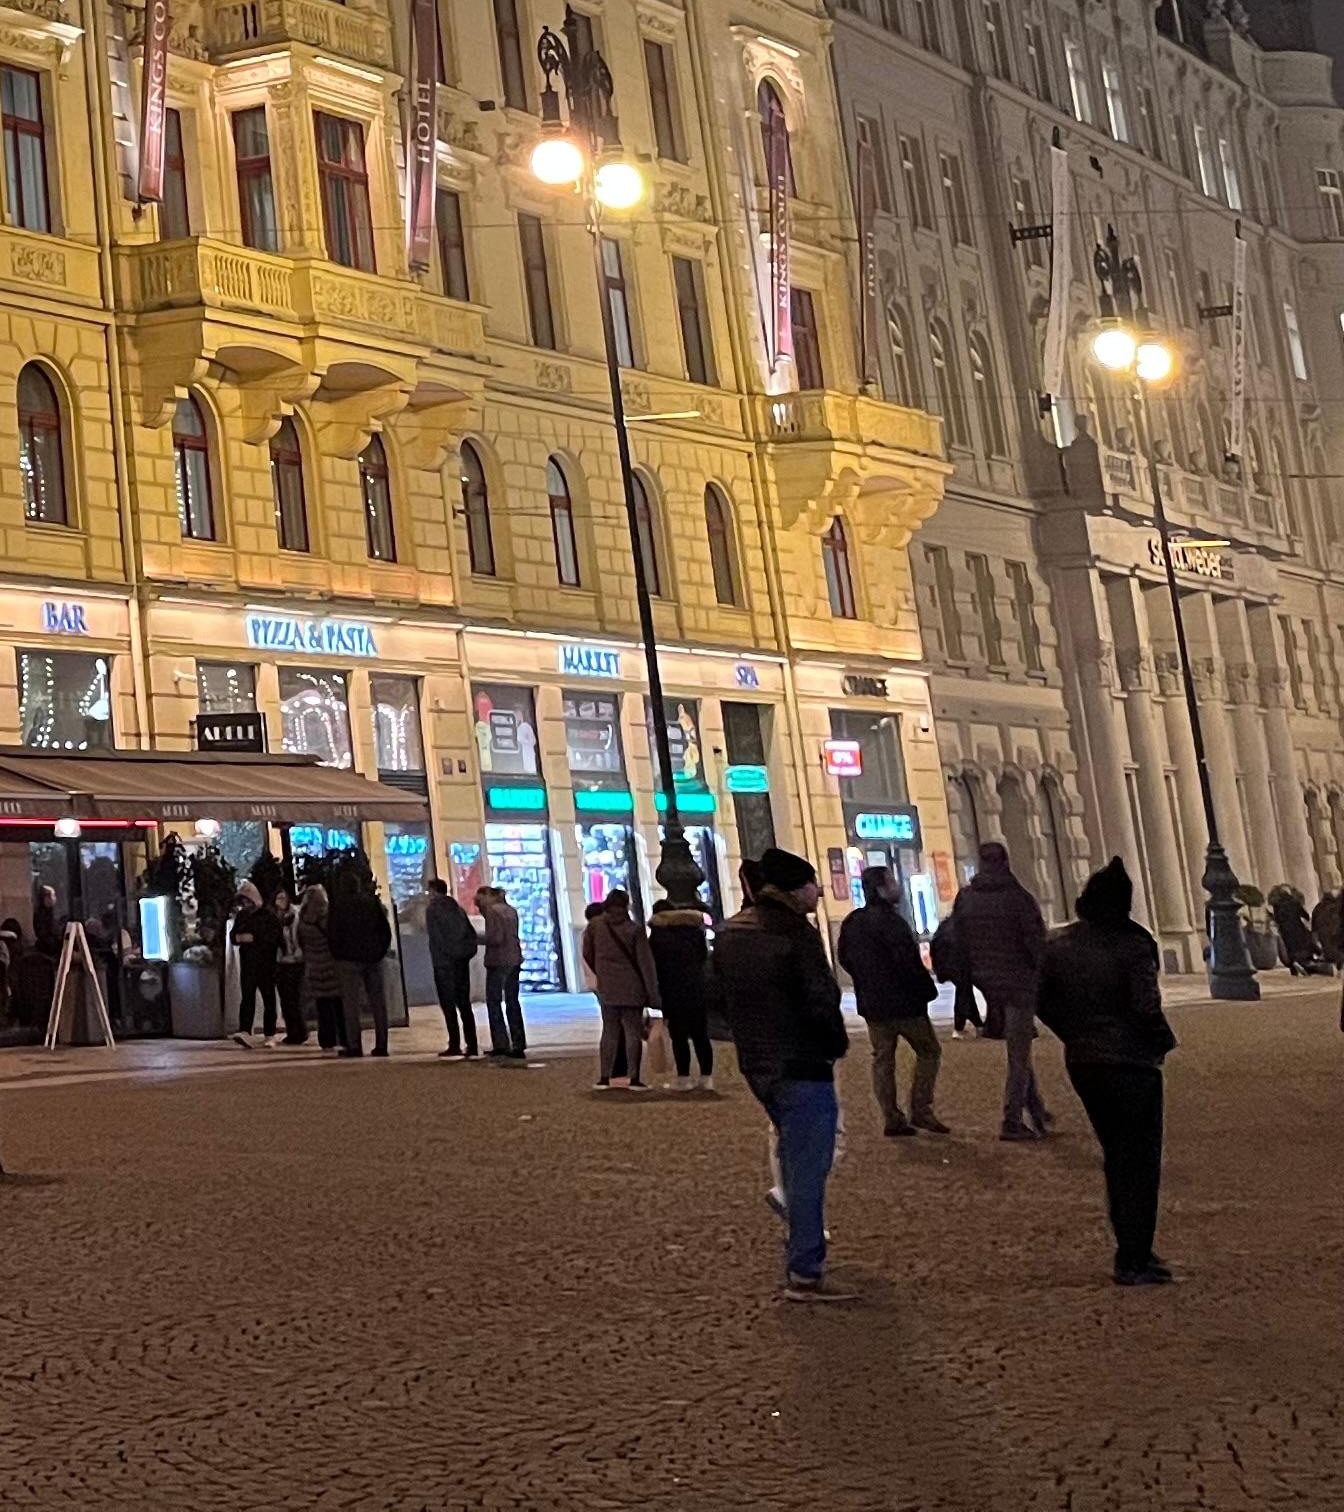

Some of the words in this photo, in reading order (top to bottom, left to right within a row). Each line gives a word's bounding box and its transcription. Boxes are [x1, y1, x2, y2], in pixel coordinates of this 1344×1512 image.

[149, 48, 165, 134] KINGS
[416, 77, 431, 164] HOTEL
[778, 244, 788, 308] KINGS
[43, 600, 88, 633] BAR
[323, 623, 379, 655] PASTA
[857, 813, 913, 839] CHANGE
